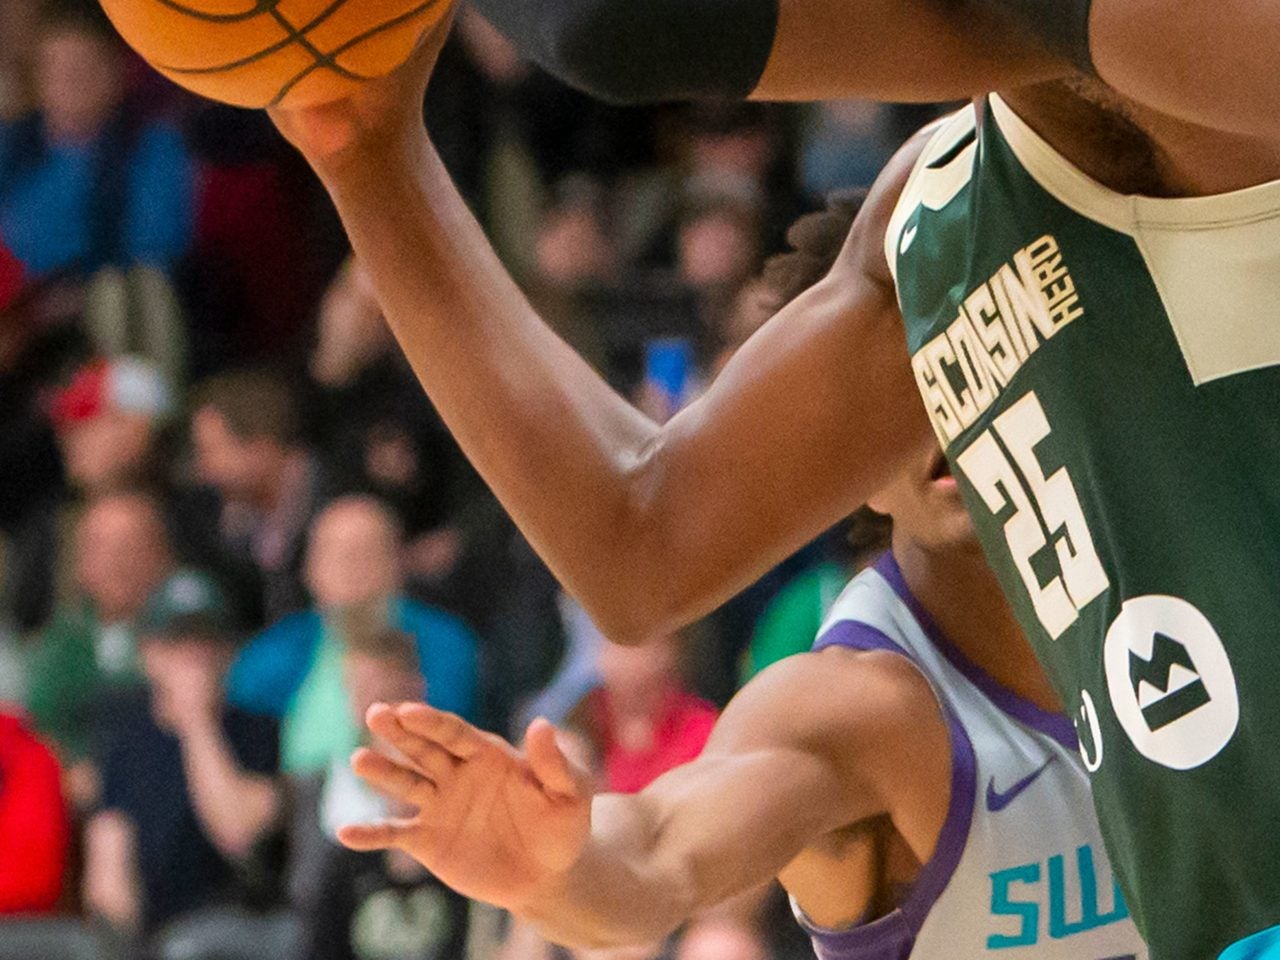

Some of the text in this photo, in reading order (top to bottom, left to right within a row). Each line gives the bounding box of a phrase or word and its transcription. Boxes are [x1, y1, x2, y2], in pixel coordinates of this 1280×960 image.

[911, 248, 1050, 450] SCONSIN
[1025, 234, 1084, 332] HERD
[957, 390, 1110, 640] 25
[986, 844, 1130, 950] SW
